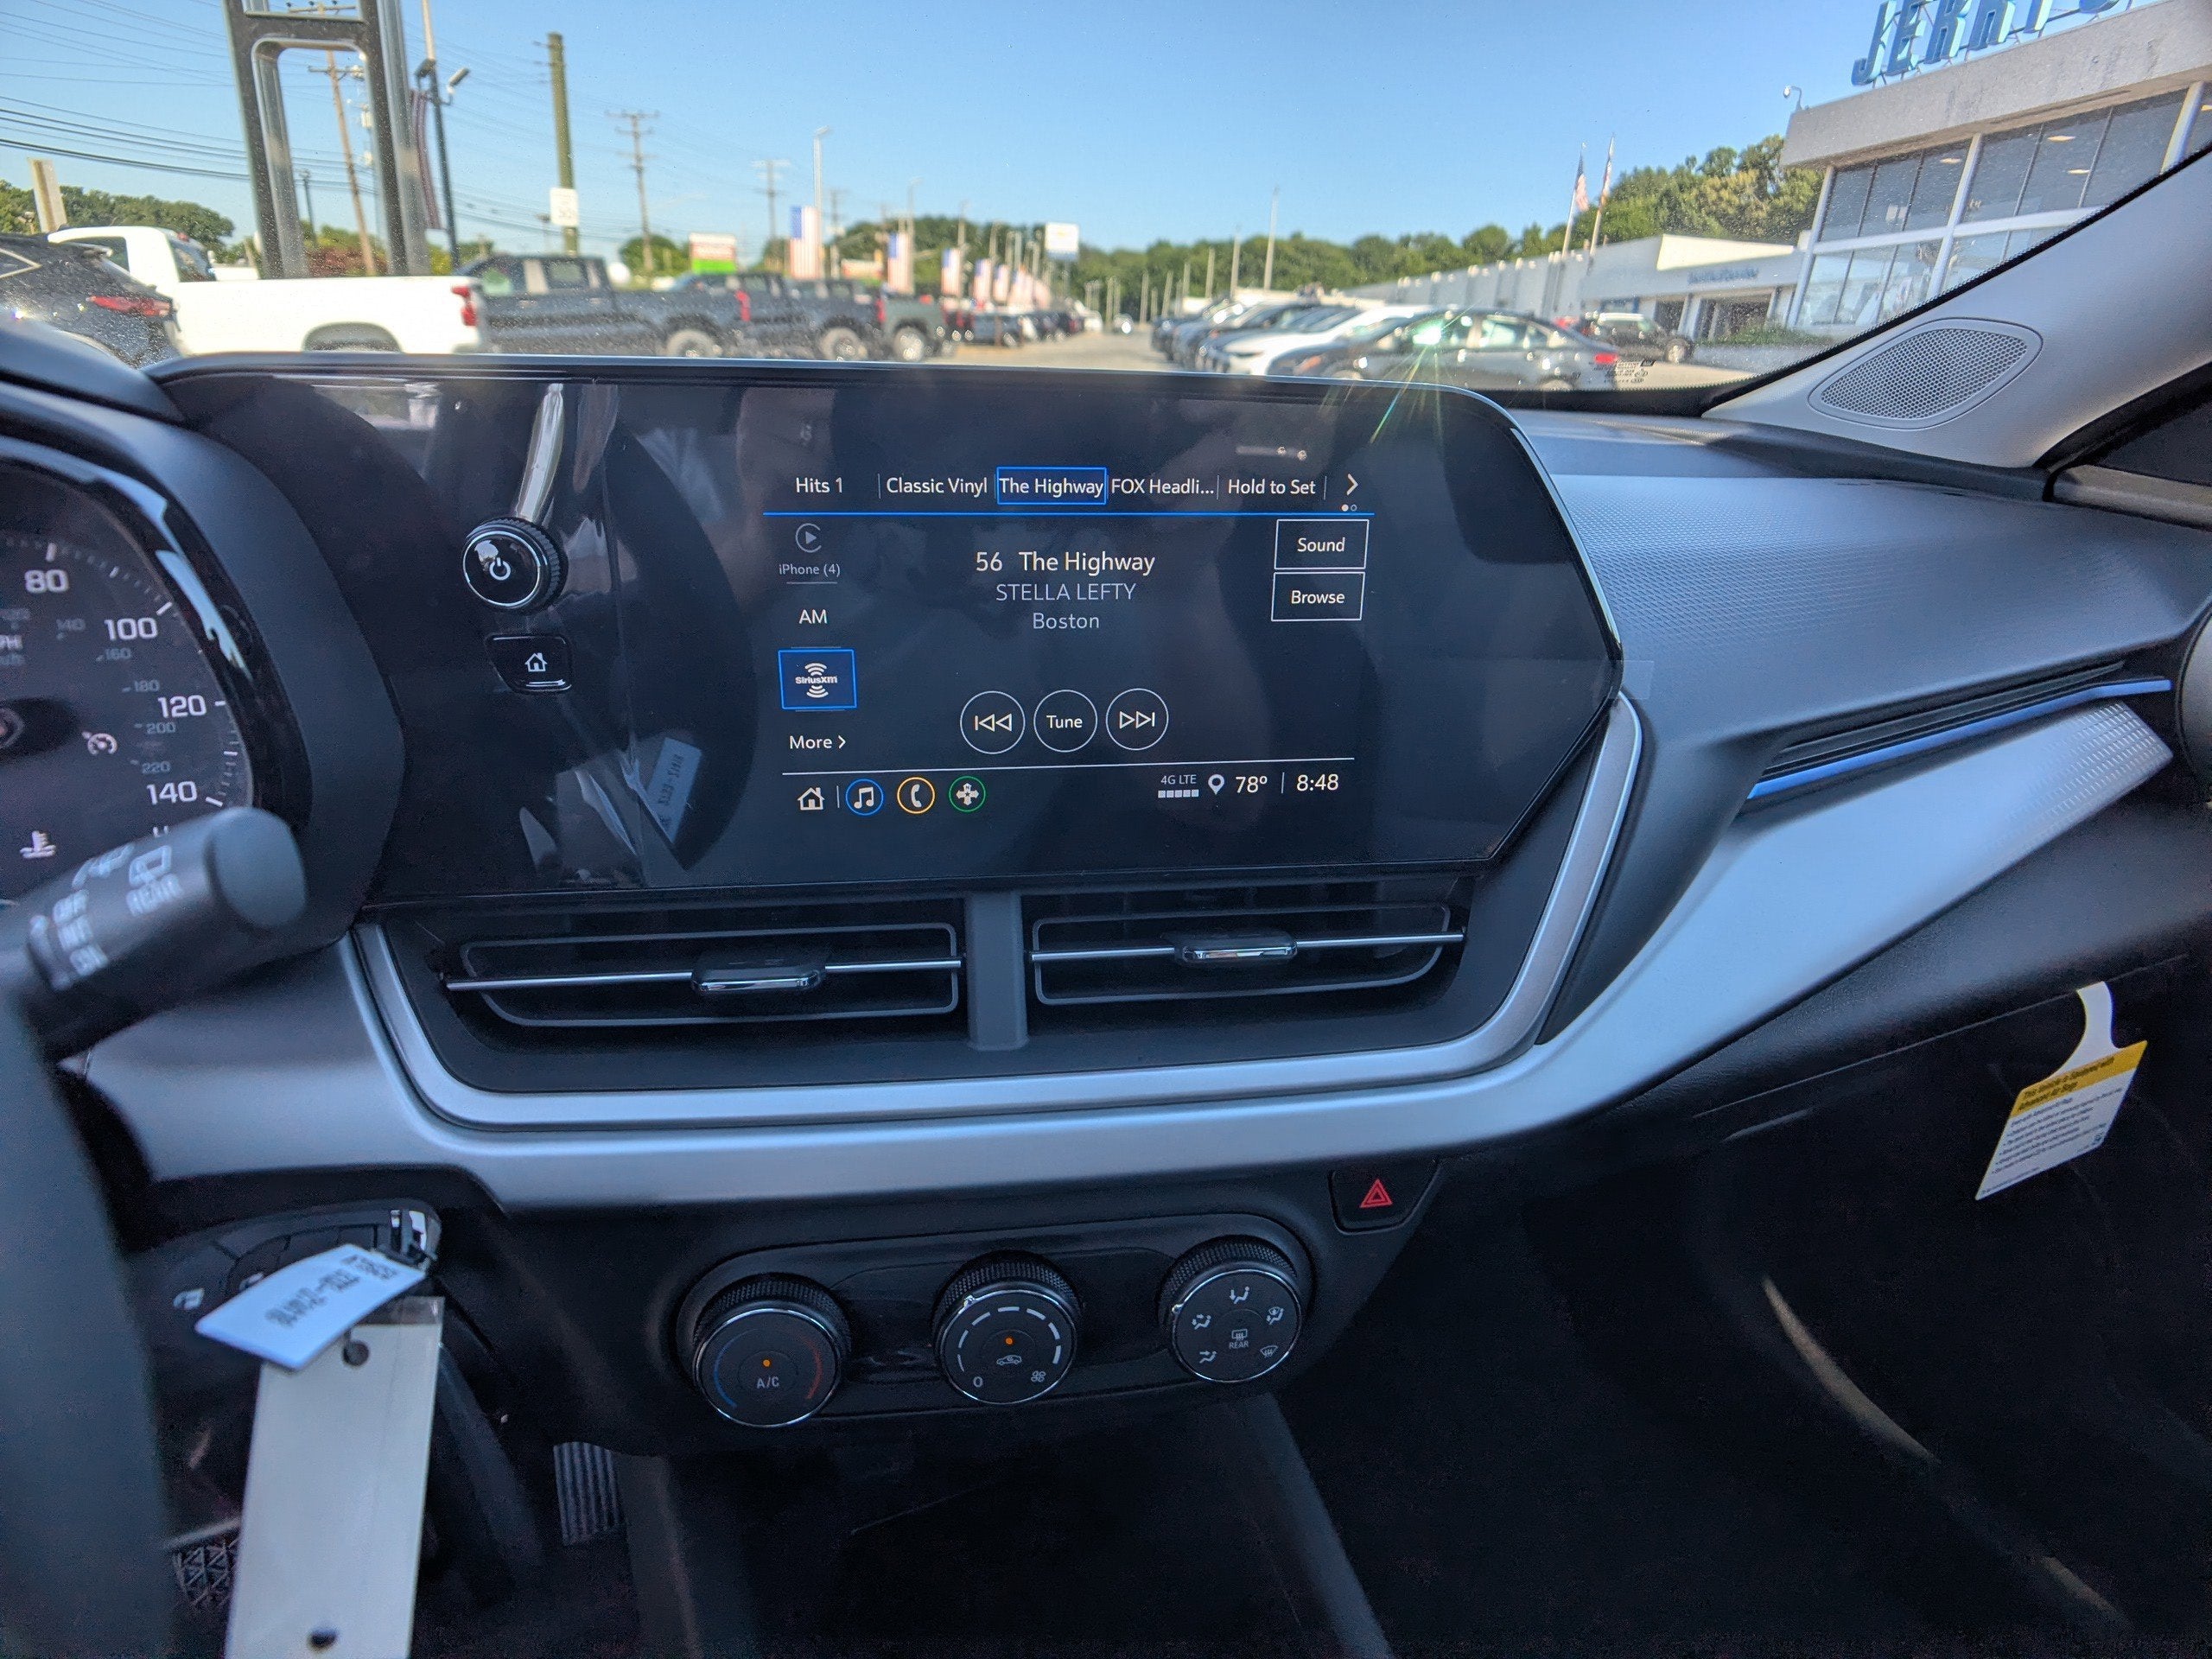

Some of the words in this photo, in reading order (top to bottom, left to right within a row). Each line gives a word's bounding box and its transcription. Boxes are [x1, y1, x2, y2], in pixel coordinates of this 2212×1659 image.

[797, 478, 830, 494] Hits
[836, 478, 843, 494] 1
[887, 478, 944, 494] Classic
[948, 478, 989, 499] Vinyl
[1000, 478, 1031, 495] The
[1035, 478, 1104, 499] Highway
[1111, 479, 1146, 494] FOX
[1150, 479, 1215, 494] Headli...
[1228, 479, 1265, 495] Hold
[1271, 480, 1287, 495] to
[1290, 480, 1317, 495] Set
[1297, 537, 1346, 553] Sound
[779, 564, 820, 575] iPhone
[823, 563, 842, 578] (4)
[976, 552, 1004, 573] 56
[1019, 551, 1059, 572] The
[1065, 551, 1157, 577] Highway
[24, 569, 68, 594] 80
[995, 584, 1071, 602] STELLA
[1077, 583, 1138, 601] LEFTY
[1292, 590, 1346, 605] Browse
[799, 609, 830, 625] AM
[1033, 613, 1101, 631] Boston
[104, 617, 158, 641] 100
[157, 694, 207, 718] 120
[1046, 715, 1084, 730] Tune
[790, 736, 833, 750] More
[1160, 774, 1176, 785] 4G
[1179, 774, 1198, 785] LTE
[1297, 773, 1339, 791] 8:48
[146, 781, 198, 805] 140
[1228, 1339, 1249, 1350] REAR
[756, 1376, 780, 1390] A/C
